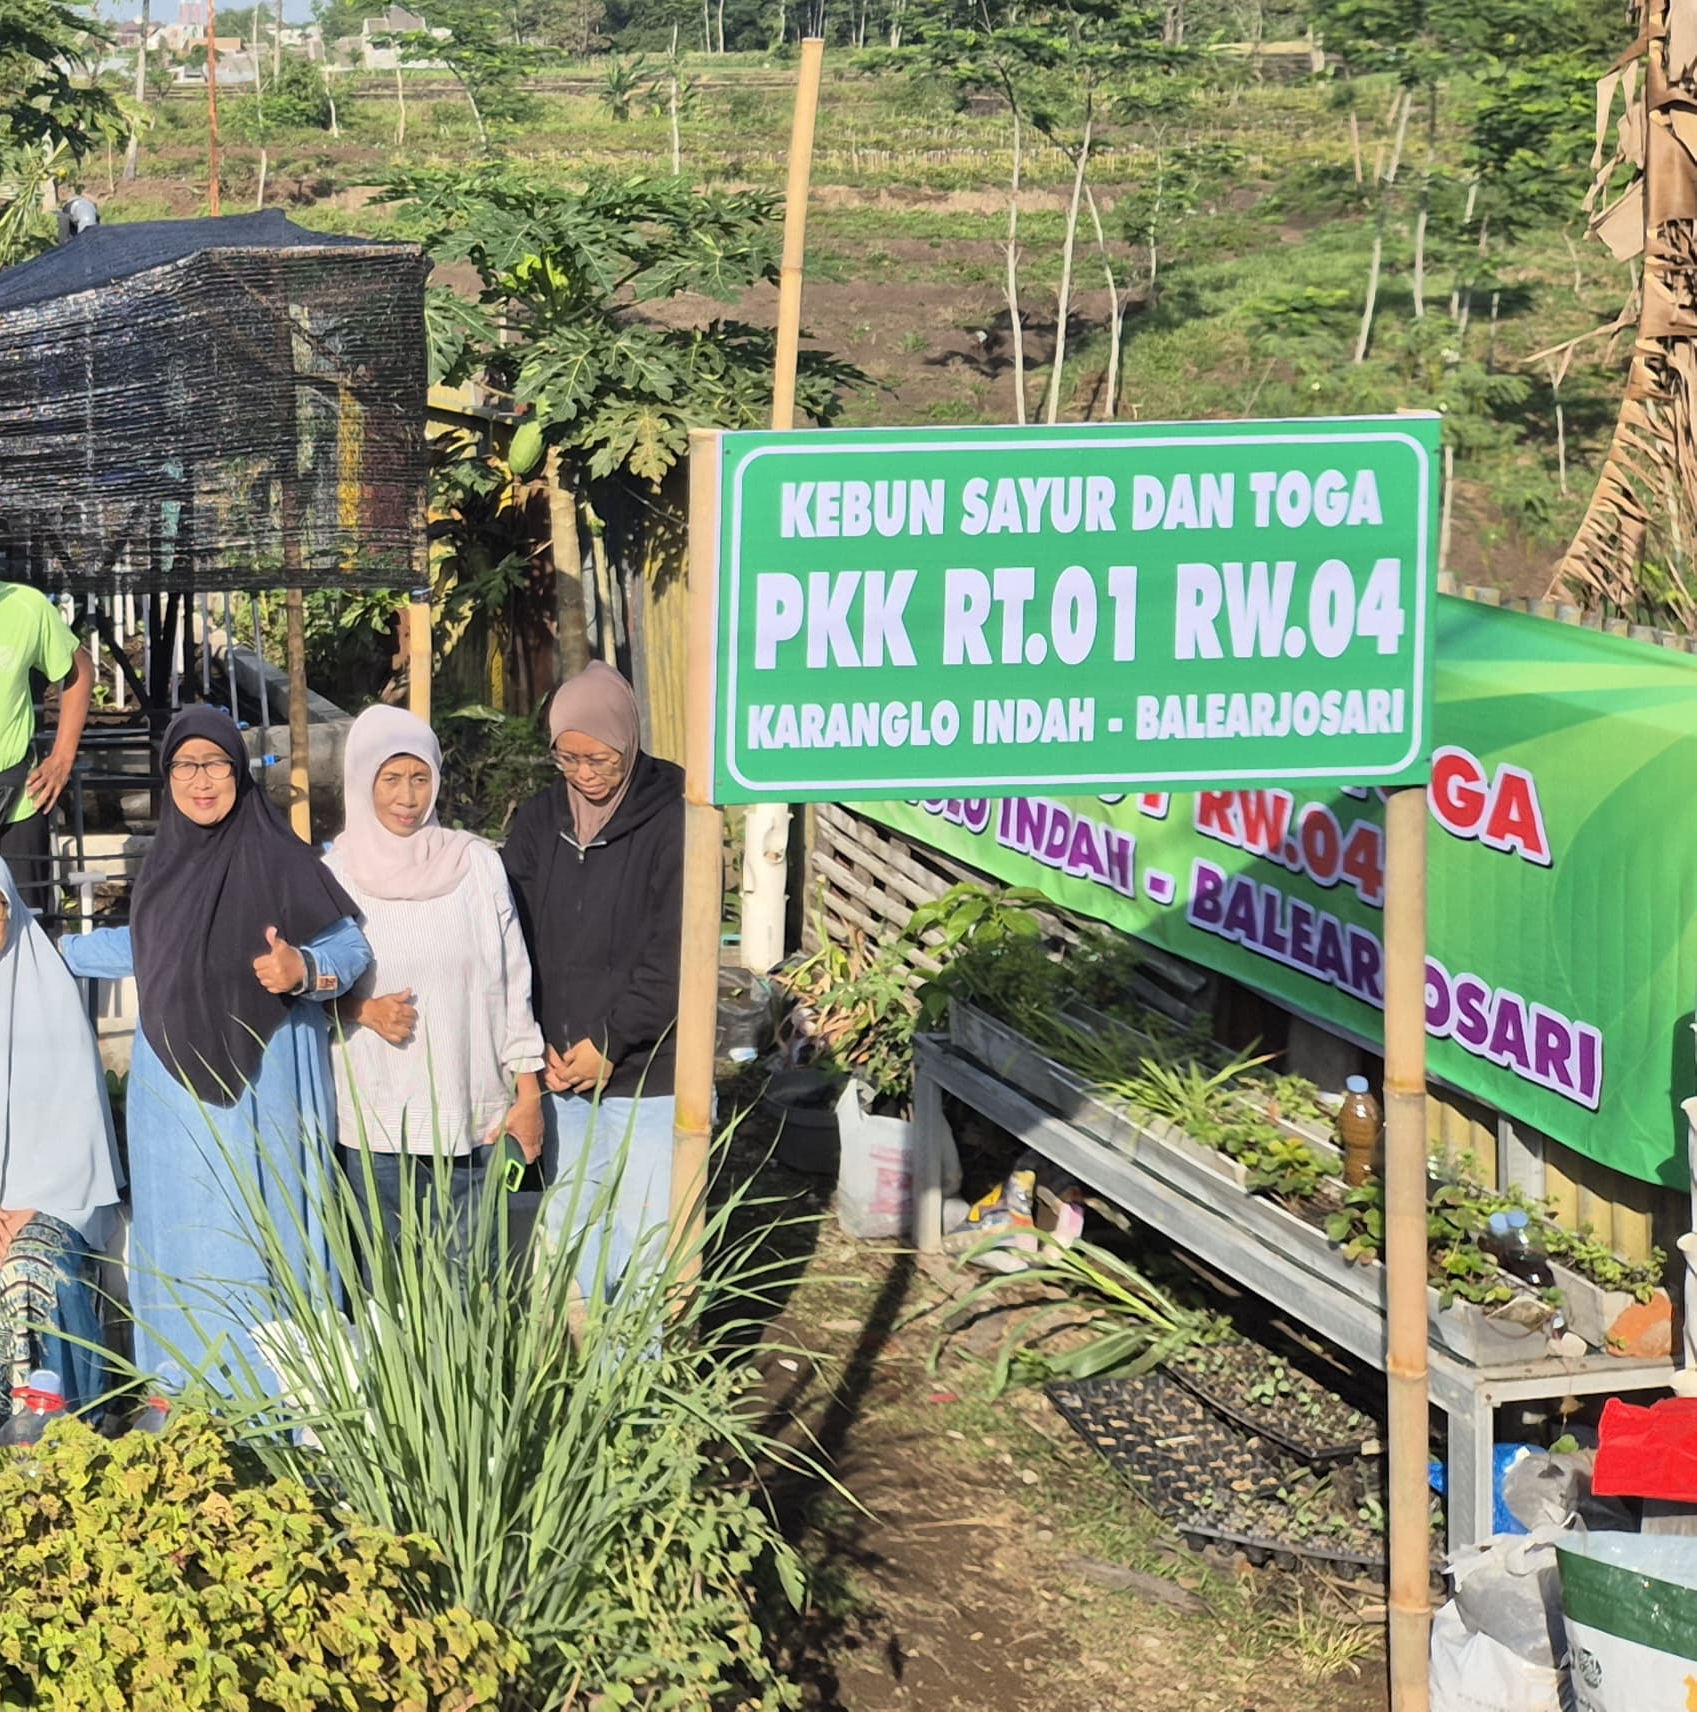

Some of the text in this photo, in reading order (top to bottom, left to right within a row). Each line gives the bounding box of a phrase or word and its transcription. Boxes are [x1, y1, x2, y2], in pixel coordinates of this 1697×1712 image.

[781, 469, 1383, 538] KEBUN SAYUR DAN TOGA
[754, 558, 1405, 670] PKK RT.01 RW.04
[747, 688, 1405, 750] KARANGLO INDAH - BALEARJOSARI
[1377, 746, 1551, 866] GA
[999, 797, 1133, 893] INDAH
[1190, 859, 1600, 1108] BALEAROSARI
